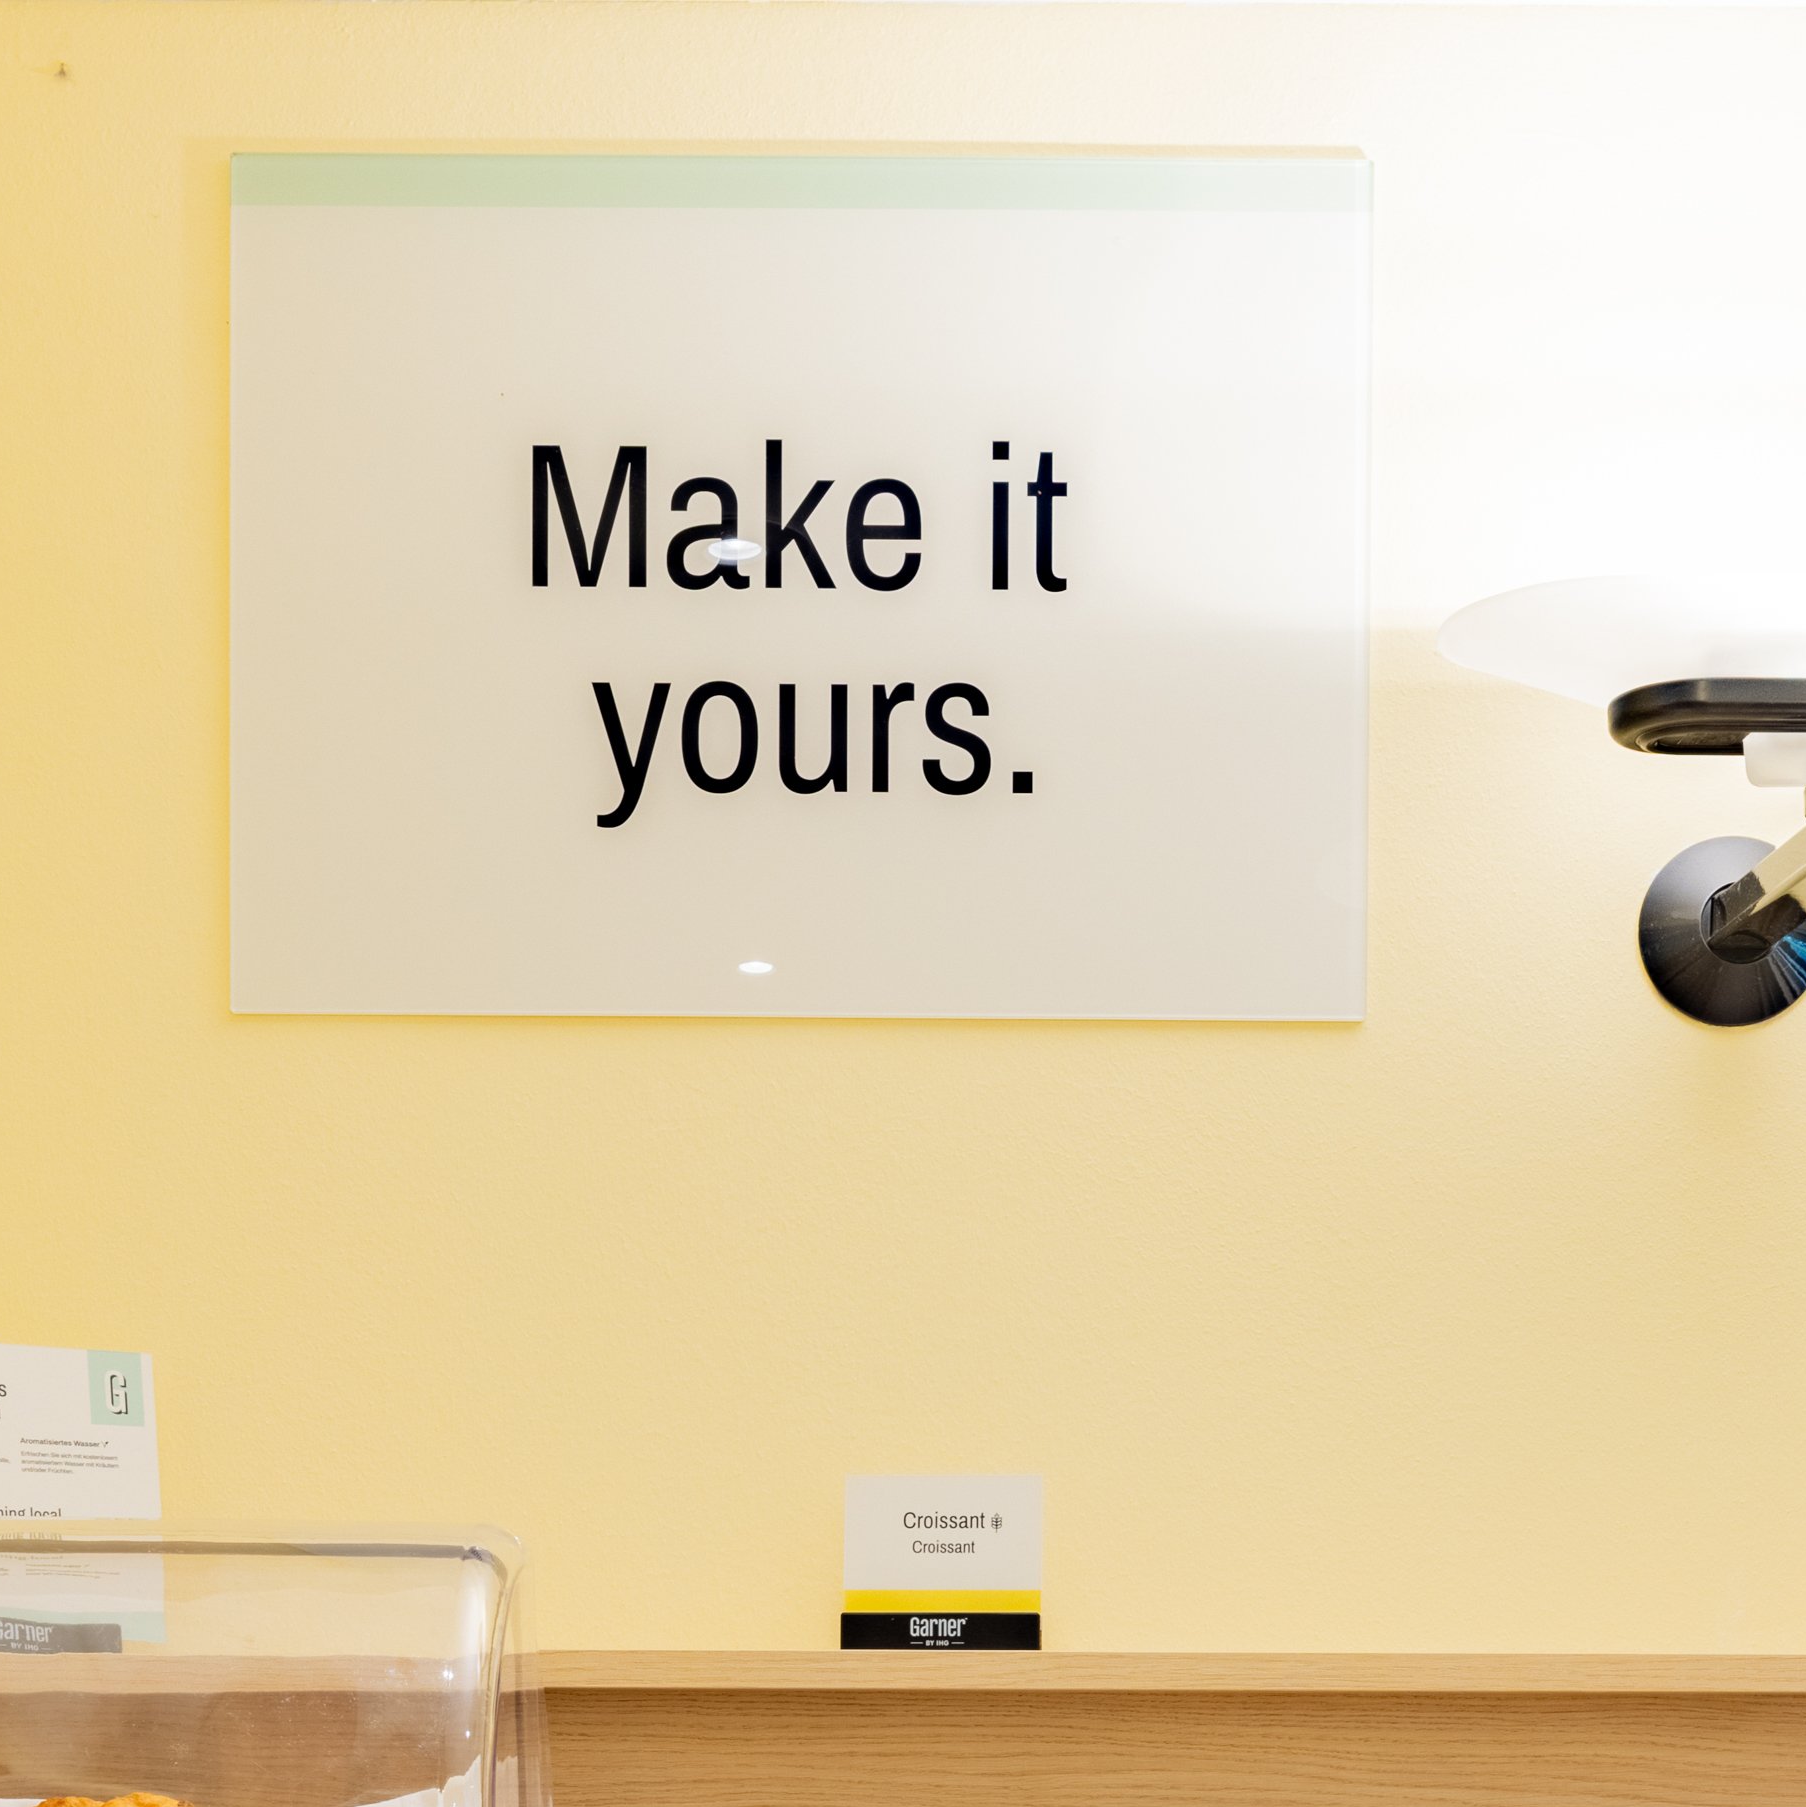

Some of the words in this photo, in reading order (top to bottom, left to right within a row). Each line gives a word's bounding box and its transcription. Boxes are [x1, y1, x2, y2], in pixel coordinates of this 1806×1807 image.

[530, 439, 923, 592] Make
[991, 440, 1069, 593] it
[591, 680, 1036, 829] yours.
[105, 1370, 128, 1415] G
[903, 1511, 986, 1530] Croissant
[912, 1540, 976, 1554] Croissant
[910, 1616, 967, 1637] Garner
[925, 1639, 935, 1647] BY
[936, 1639, 950, 1647] IHG
